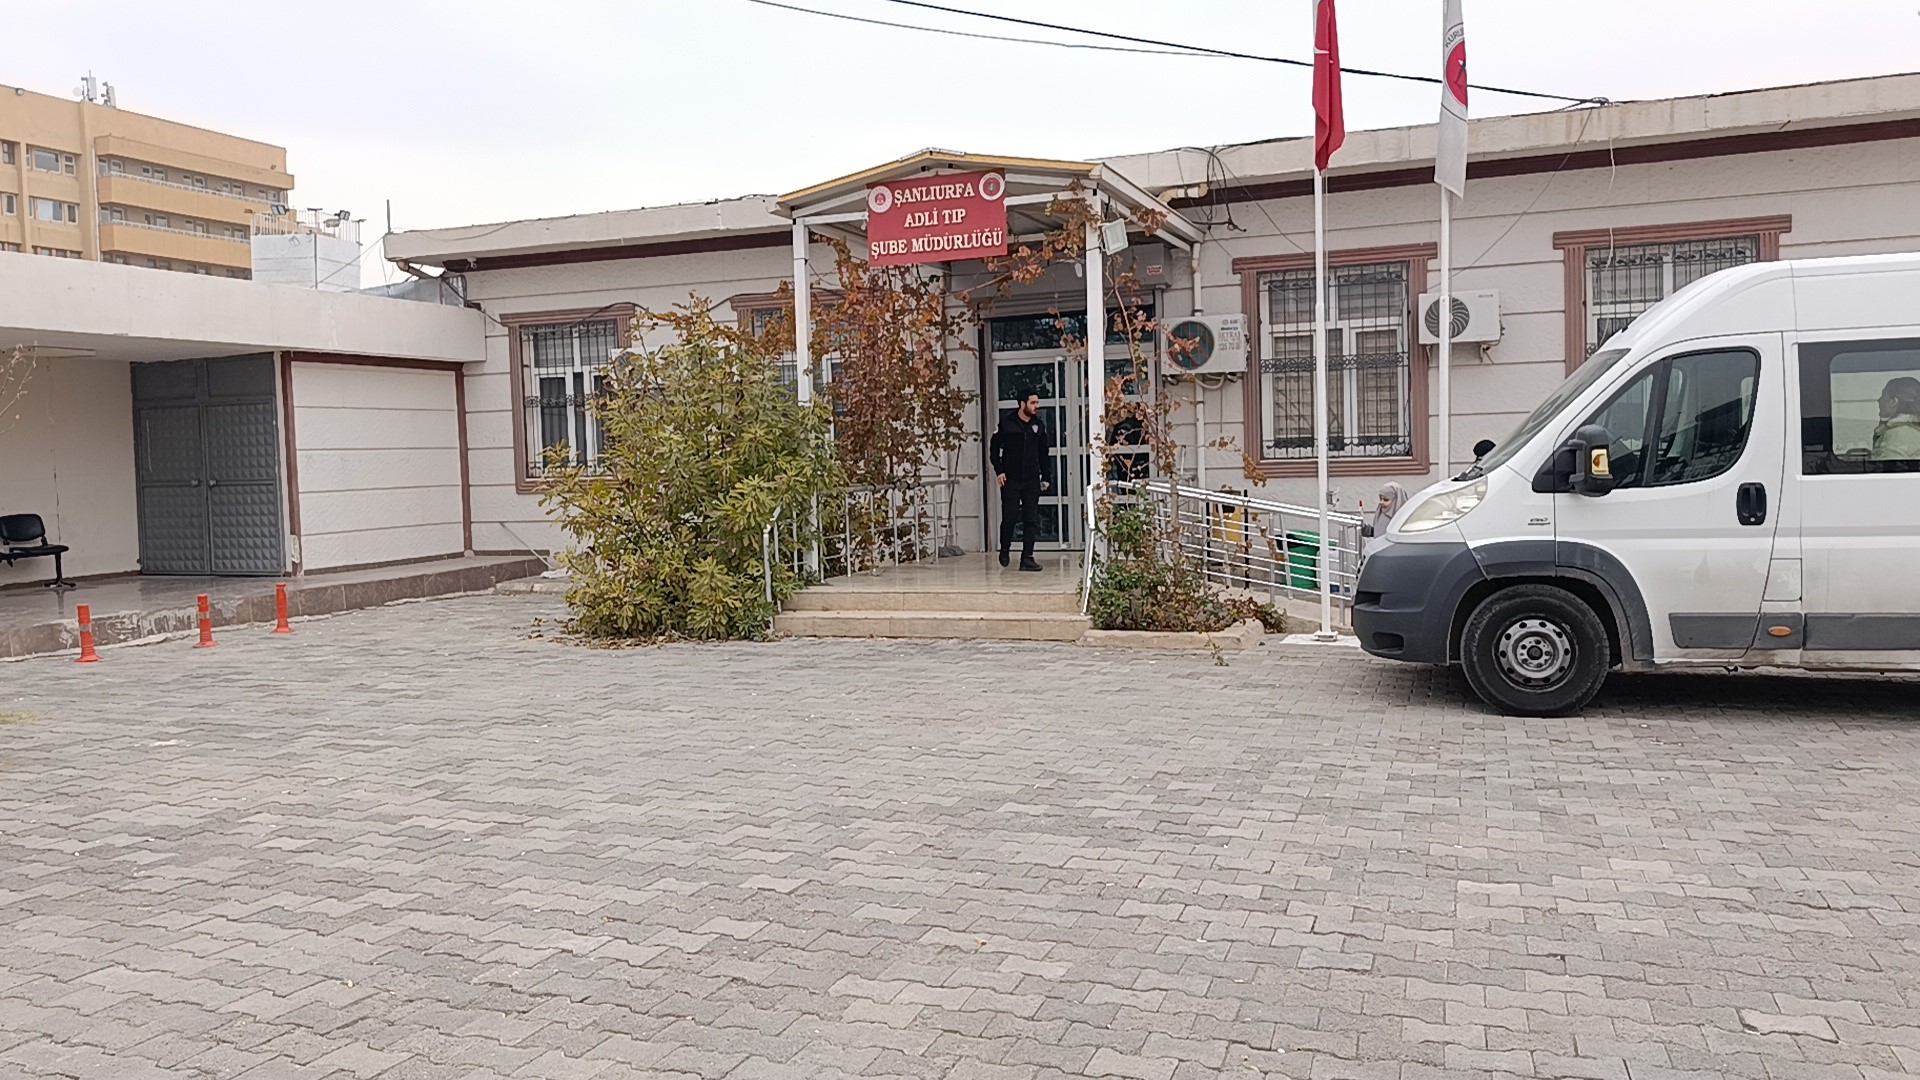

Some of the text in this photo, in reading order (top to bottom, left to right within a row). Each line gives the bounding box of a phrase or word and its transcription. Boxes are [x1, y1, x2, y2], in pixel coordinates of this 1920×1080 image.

[894, 182, 975, 207] ŞANLIURFA
[904, 207, 966, 228] ADLİ TIP
[871, 227, 1003, 259] ŞUBE MÜDÜRLÜĞÜ
